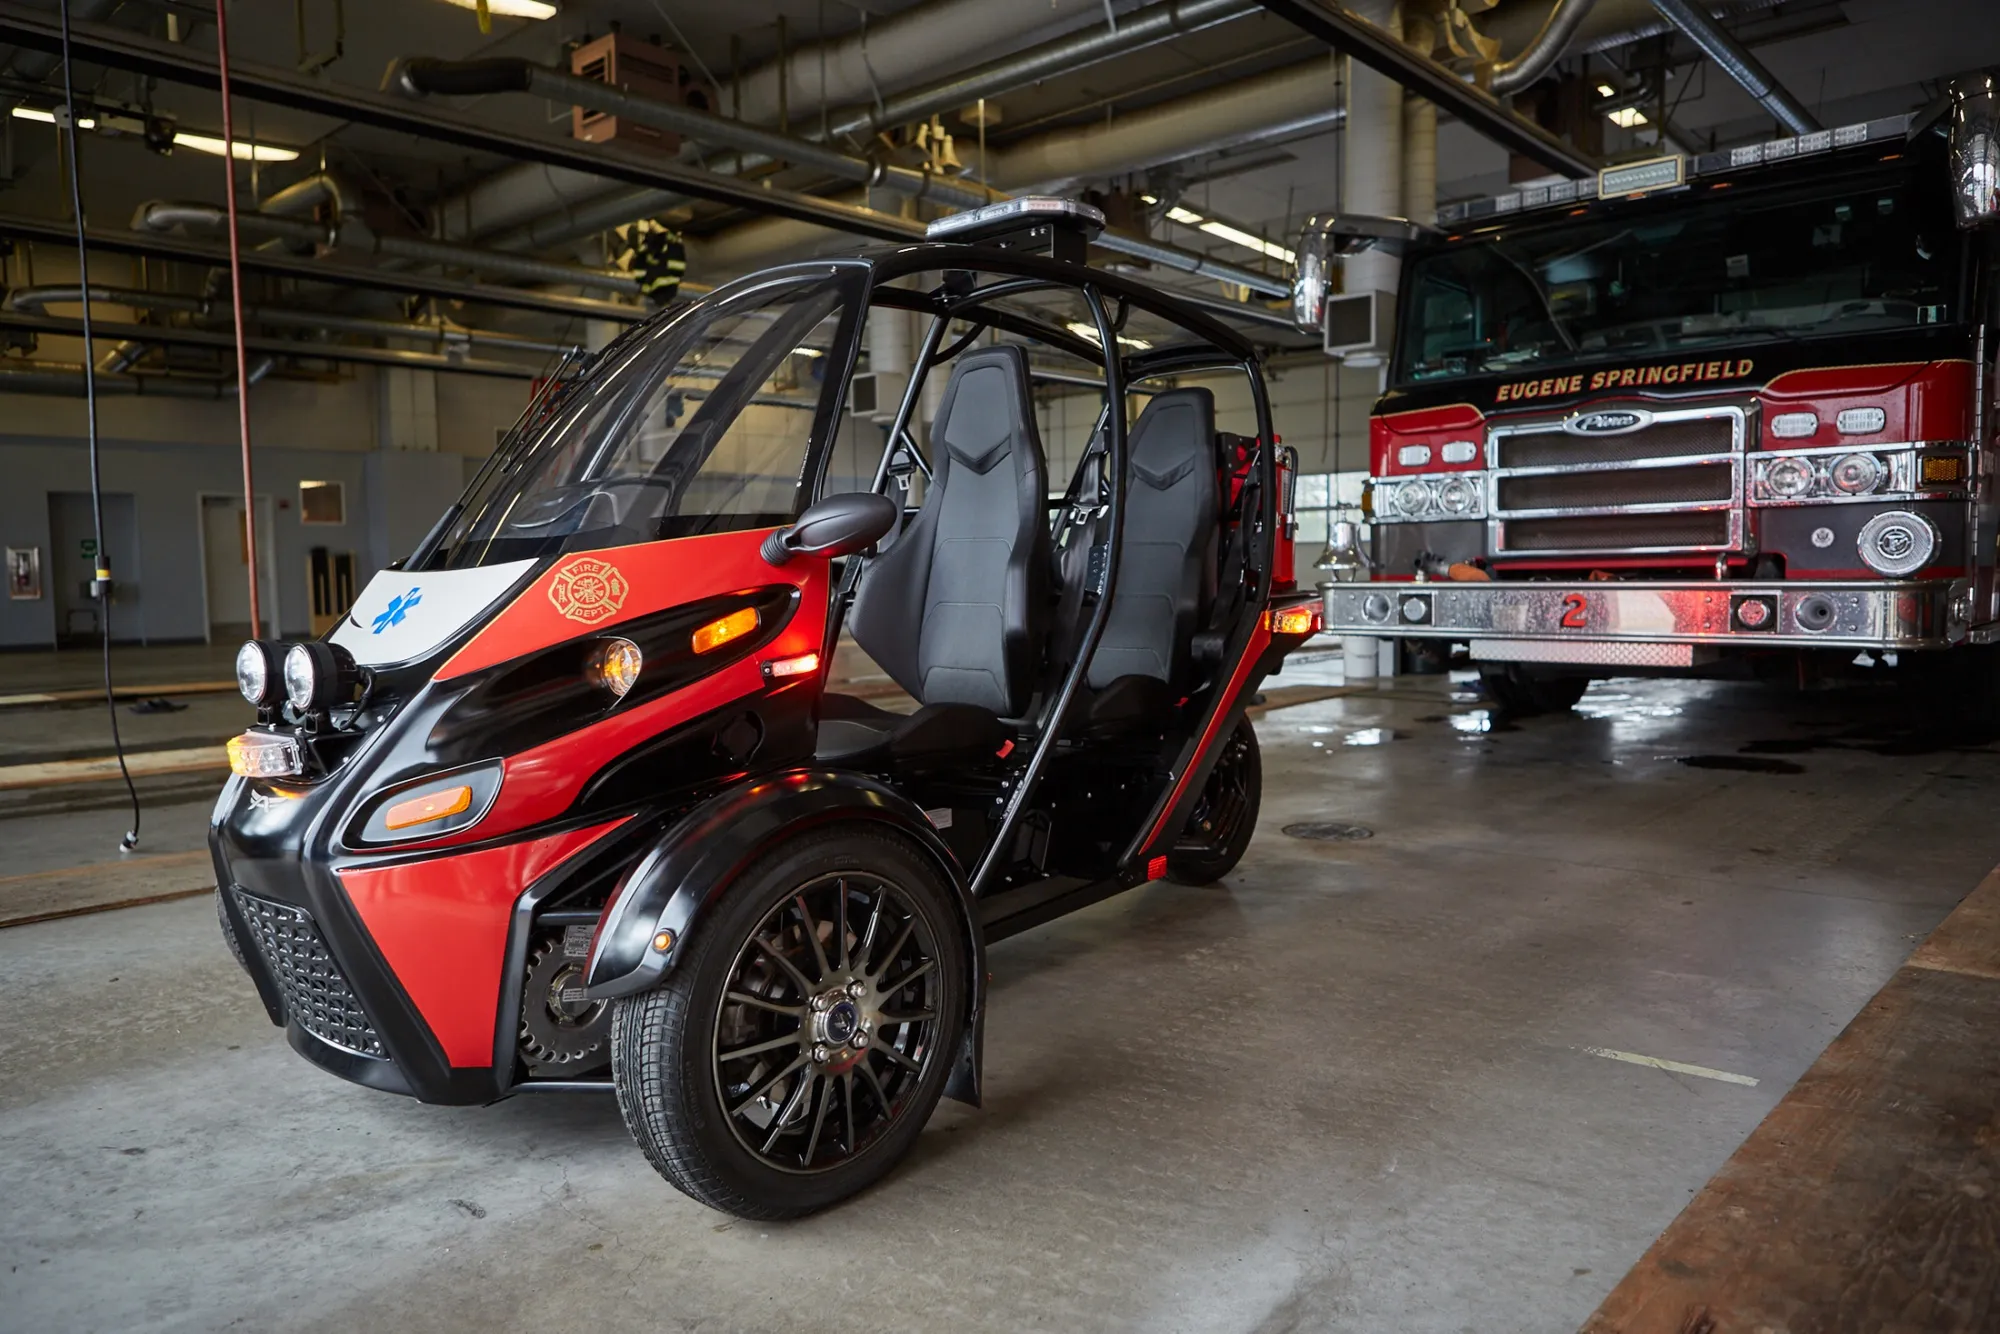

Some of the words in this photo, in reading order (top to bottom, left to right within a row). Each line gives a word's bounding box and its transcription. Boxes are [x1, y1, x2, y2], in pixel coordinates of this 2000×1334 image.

[1496, 374, 1583, 402] EUGENE
[1589, 359, 1754, 390] SPRINGFIELD
[572, 564, 600, 574] FIRE
[575, 607, 609, 617] DEPT.
[1560, 593, 1587, 628] 2
